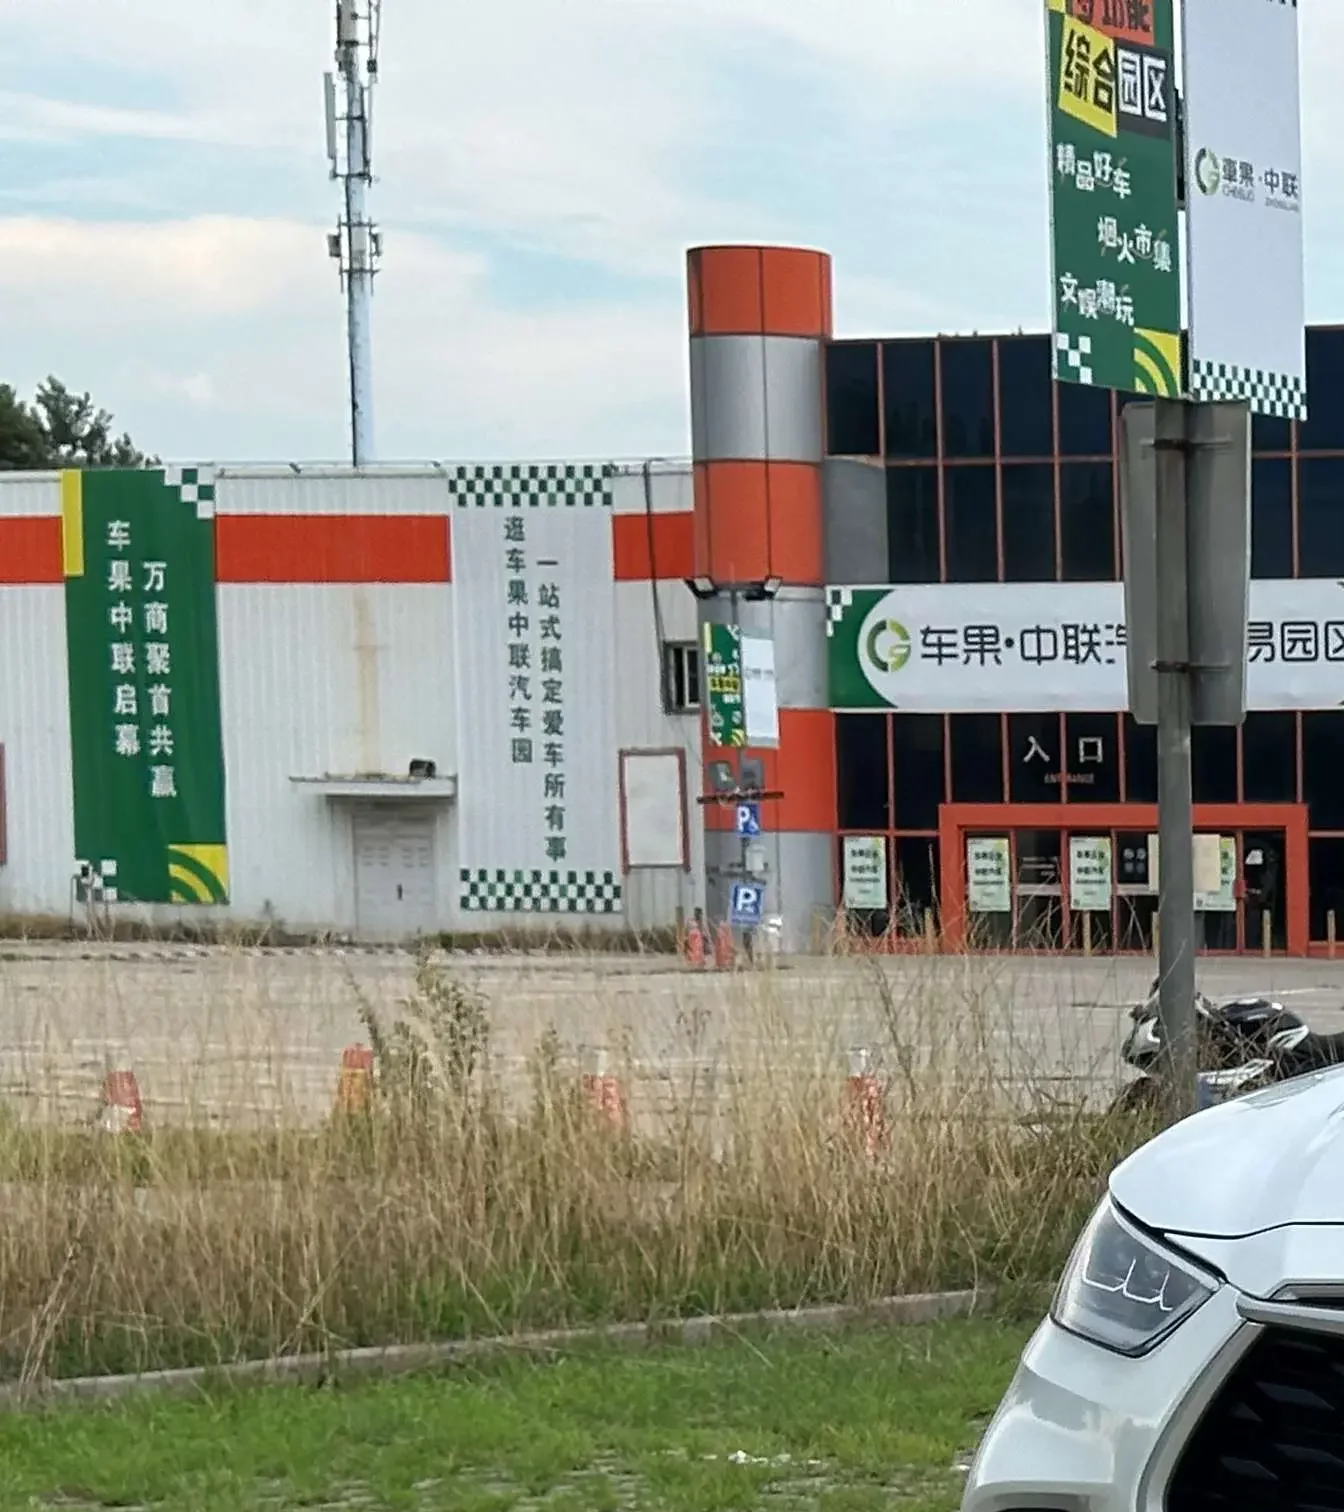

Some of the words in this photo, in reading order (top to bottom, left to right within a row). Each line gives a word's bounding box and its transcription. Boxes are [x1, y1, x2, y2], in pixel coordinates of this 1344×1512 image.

[1064, 28, 1168, 121] 综合园区
[1057, 142, 1132, 199] 精品好车
[1097, 216, 1172, 272] 烟火市集
[107, 519, 141, 756] 车果中联启幕
[142, 560, 178, 798] 万商聚首共赢
[503, 515, 533, 764] 逛车果中联汽车园
[536, 559, 567, 863] 一站式搞定爱车所有事
[1023, 735, 1103, 763] 入口
